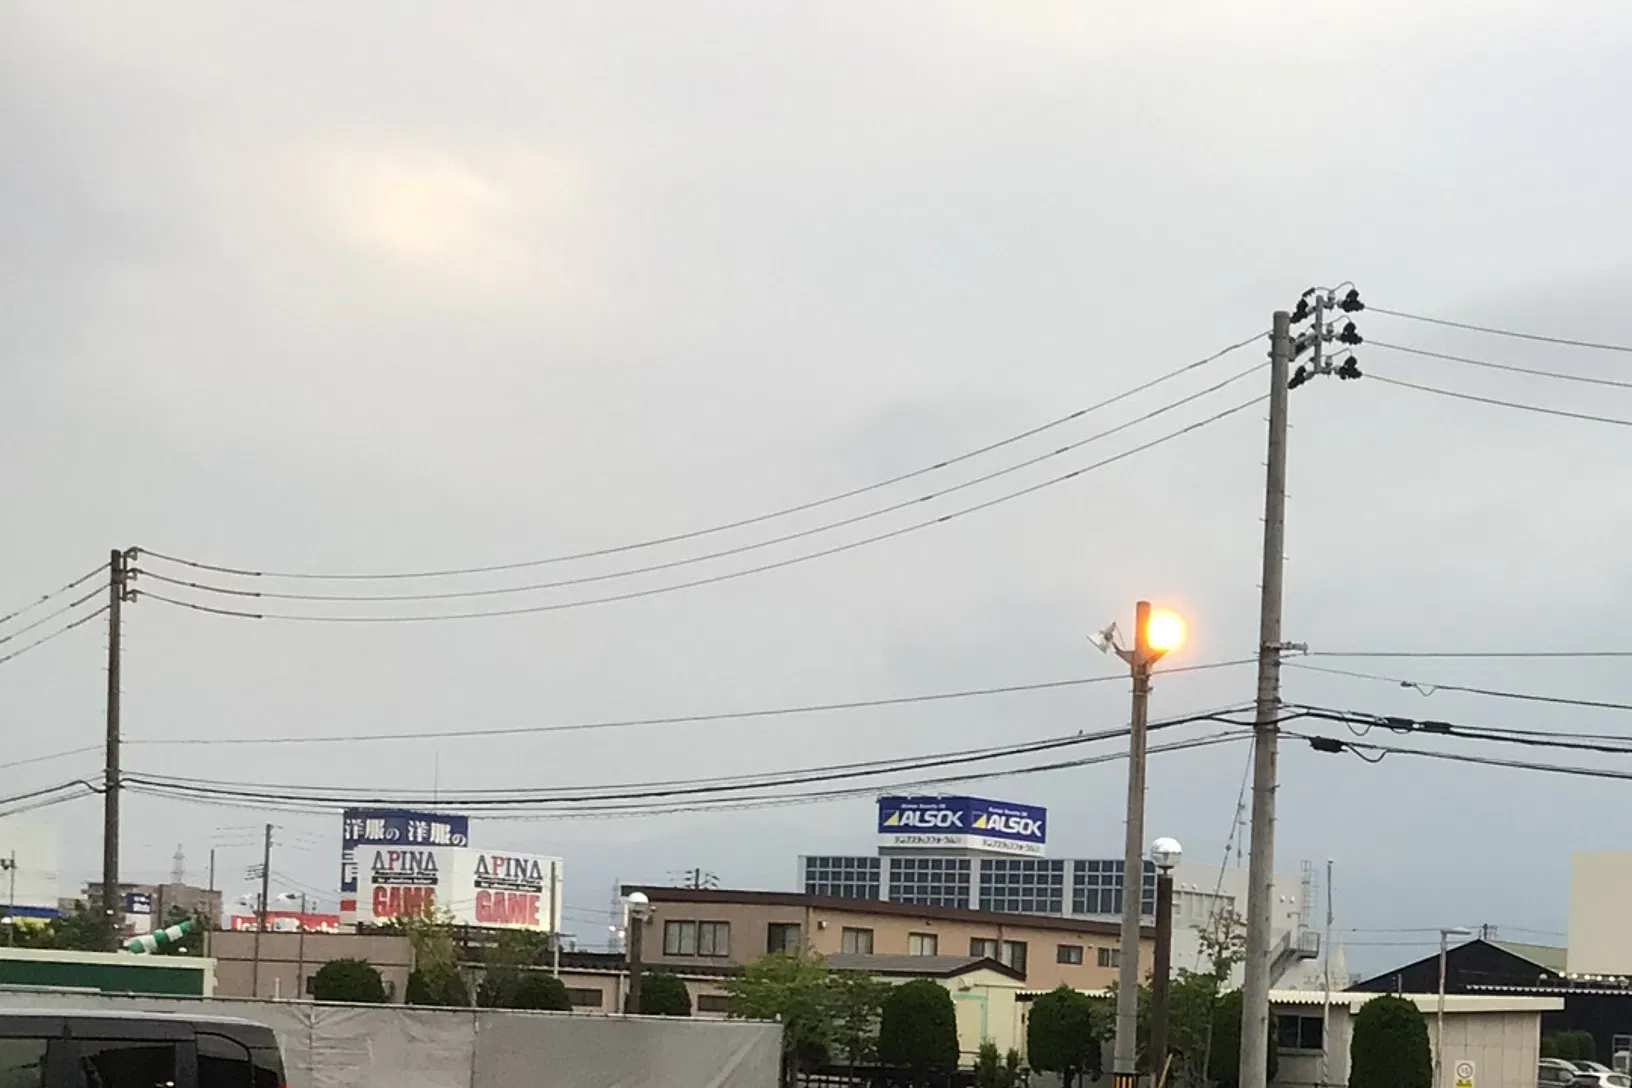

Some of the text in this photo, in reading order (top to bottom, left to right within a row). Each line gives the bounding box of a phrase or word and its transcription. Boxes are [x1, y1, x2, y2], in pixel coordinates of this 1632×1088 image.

[345, 818, 400, 841] 洋服の
[899, 810, 963, 828] ALSOK
[987, 816, 1042, 837] ALSOK
[407, 820, 467, 846] 洋服の
[372, 850, 438, 871] APINA
[474, 855, 543, 880] APINA
[476, 889, 540, 925] GAME
